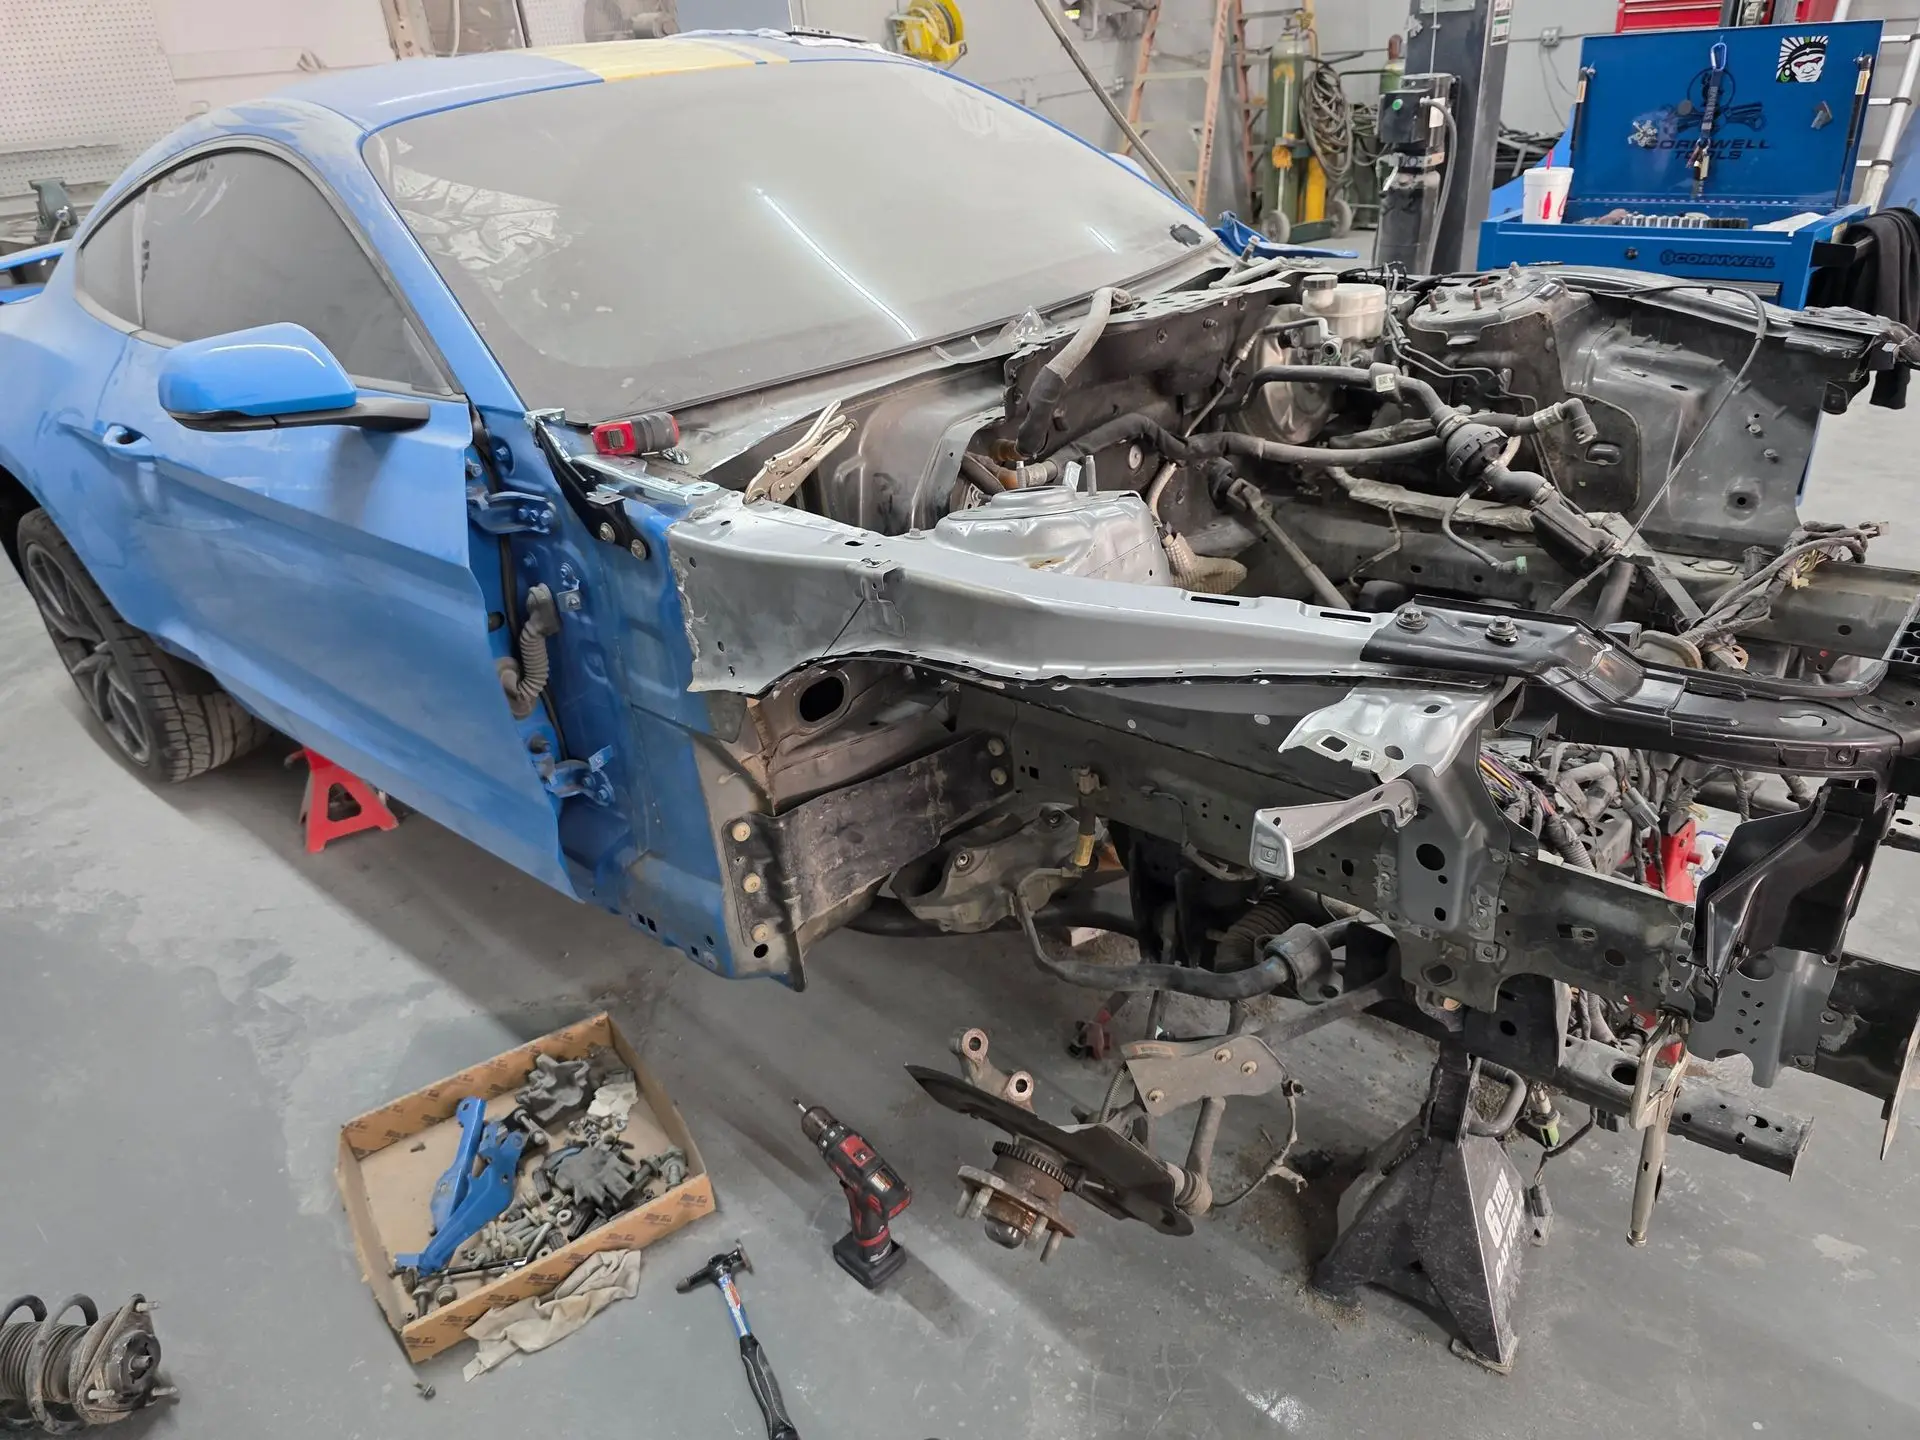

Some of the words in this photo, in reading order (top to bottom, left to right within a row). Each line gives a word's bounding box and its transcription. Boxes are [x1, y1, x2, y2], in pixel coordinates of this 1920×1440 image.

[1645, 138, 1770, 150] CORWELL
[1674, 253, 1775, 268] CORNWELL
[1492, 1168, 1510, 1213] TON
[1484, 1198, 1503, 1248] 6
